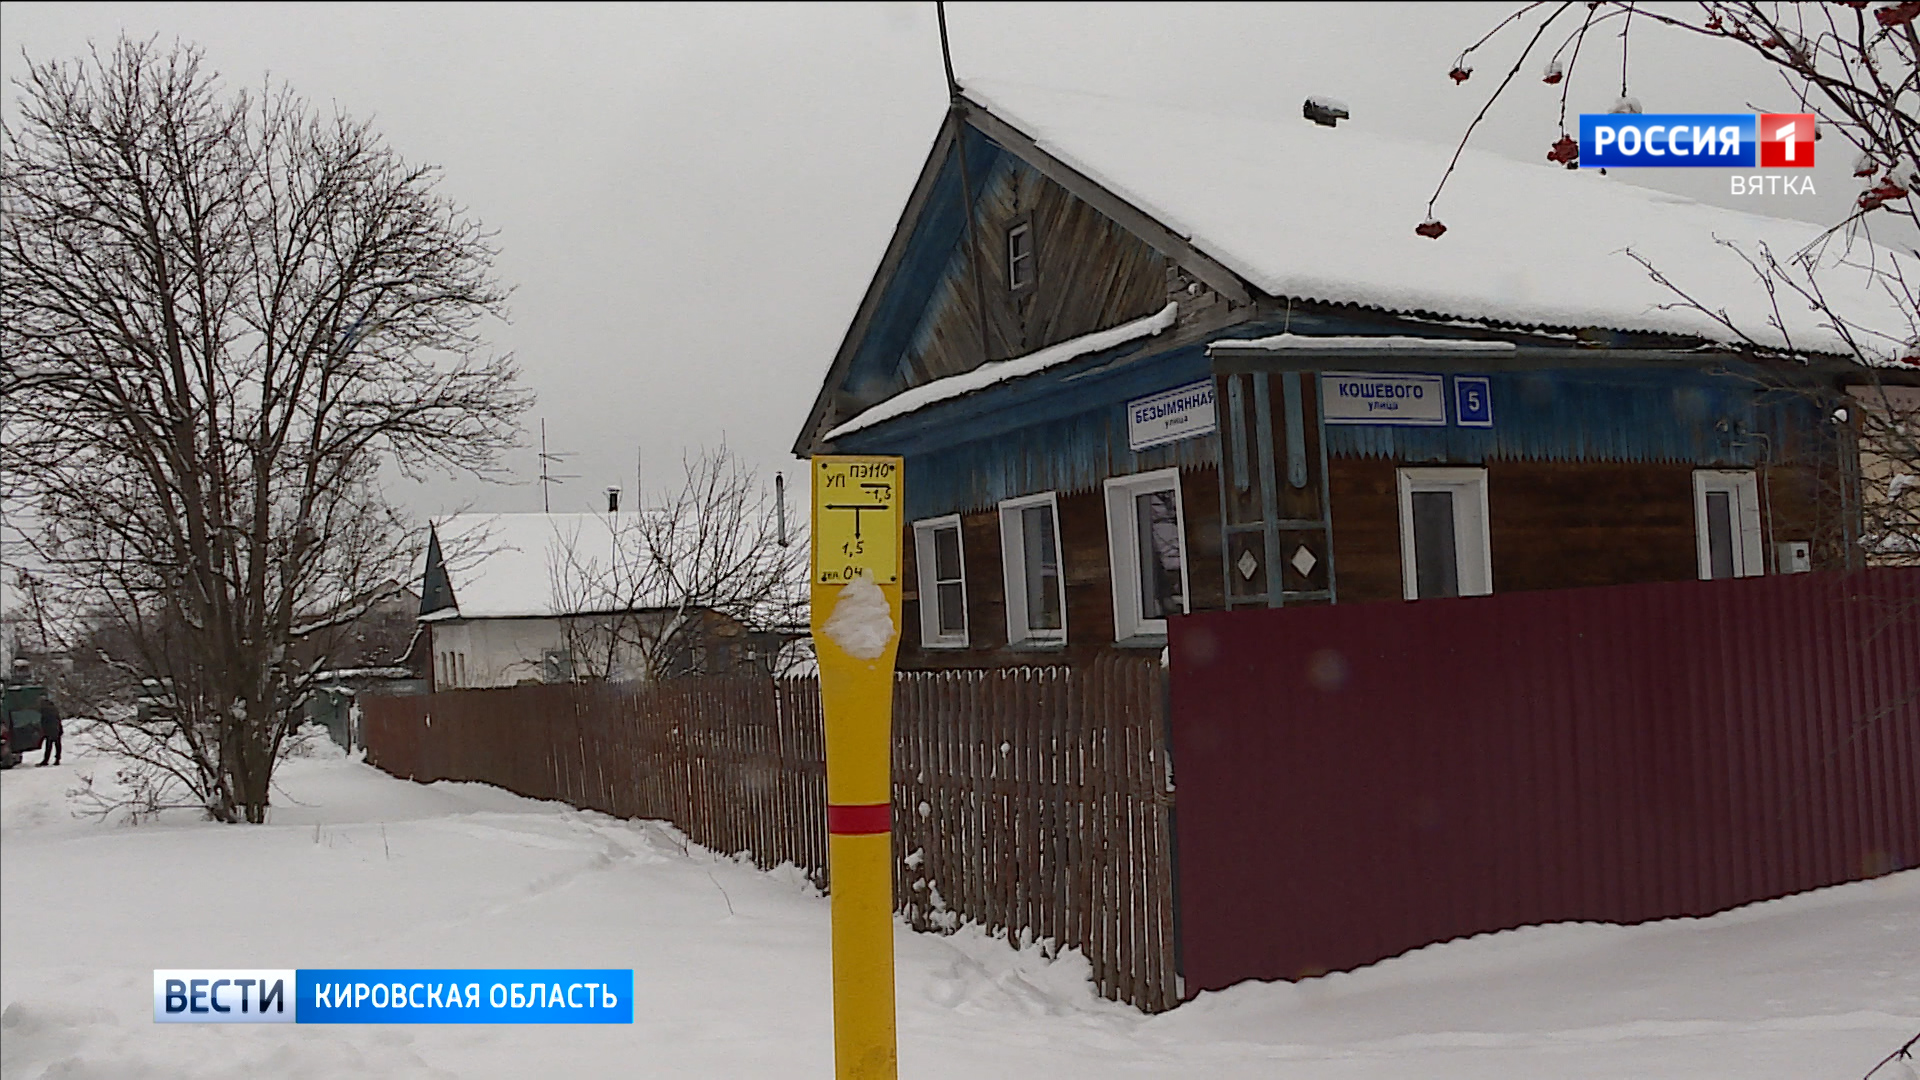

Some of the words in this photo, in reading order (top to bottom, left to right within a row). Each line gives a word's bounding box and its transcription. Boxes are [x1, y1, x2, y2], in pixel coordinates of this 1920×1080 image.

[1339, 383, 1424, 399] КОШЕВОГО
[1135, 390, 1214, 424] БЕЗЫМЯННАЯ
[1368, 401, 1399, 411] улица
[1468, 391, 1480, 412] 5
[1165, 415, 1189, 430] улица
[849, 463, 889, 478] ПЭ110
[826, 473, 845, 488] УП
[841, 540, 864, 558] 1,5
[843, 565, 863, 580] 04
